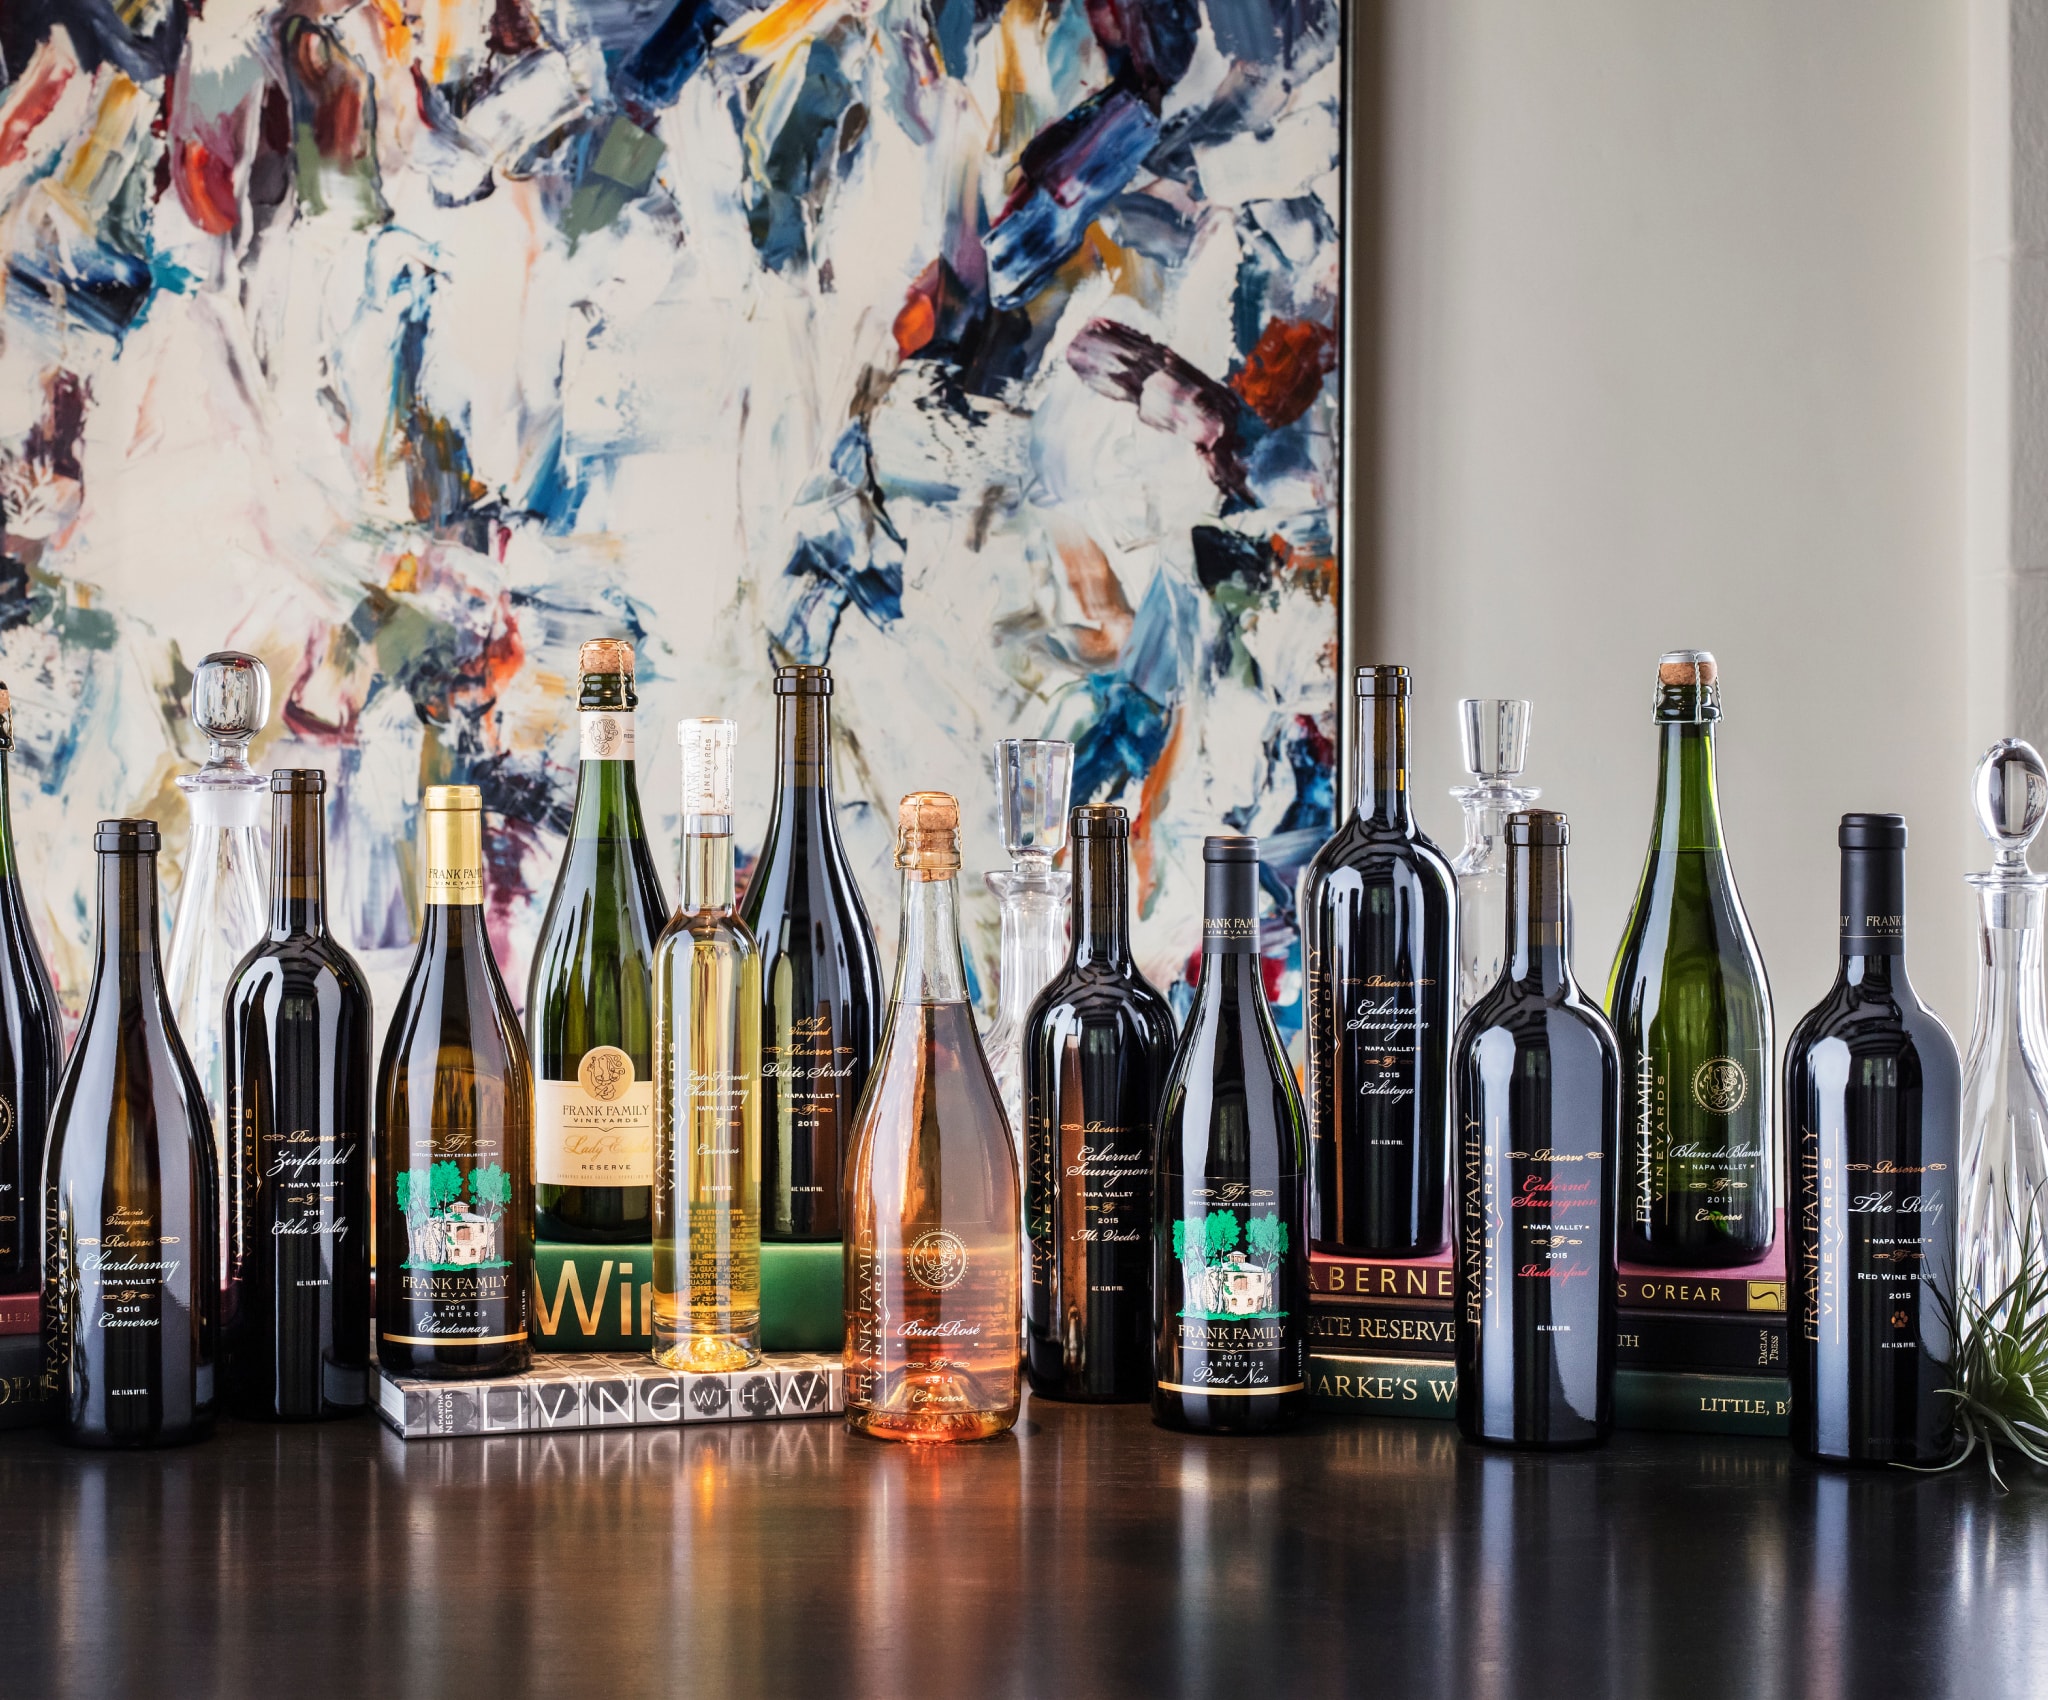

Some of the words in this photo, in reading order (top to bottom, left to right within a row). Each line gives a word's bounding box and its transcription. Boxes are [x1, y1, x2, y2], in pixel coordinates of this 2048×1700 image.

[429, 868, 461, 879] FRANK
[1364, 974, 1415, 988] Reserve
[1357, 996, 1423, 1016] Cabernet
[1345, 1014, 1431, 1042] Sauvignon
[784, 1043, 833, 1056] Reserve
[1324, 972, 1332, 1116] VINEYARDS
[761, 1062, 806, 1078] Petite
[806, 1057, 858, 1080] Sirah
[683, 1081, 750, 1105] Chardonnay
[1311, 1050, 1322, 1140] FRANK
[1360, 1079, 1415, 1105] Calistoga
[1636, 1050, 1654, 1137] FAMILY
[563, 1105, 602, 1116] FRANK
[606, 1105, 650, 1116] FAMILY
[287, 1129, 338, 1143] Reserve
[564, 1135, 603, 1161] Lady
[1029, 1092, 1042, 1185] FAMILY
[1656, 1074, 1665, 1202] VINEYARDS
[266, 1143, 356, 1178] Zinfandel
[1077, 1142, 1141, 1162] Cabernet
[1530, 1148, 1584, 1162] Reserve
[1669, 1141, 1711, 1158] Blanc
[1713, 1146, 1725, 1158] de
[1066, 1162, 1150, 1188] Sauvignon
[1465, 1112, 1481, 1220] FAMILY
[1692, 1163, 1716, 1171] NAPA
[1718, 1163, 1748, 1171] VALLEY
[1802, 1124, 1818, 1233] FAMILY
[1872, 1160, 1927, 1174] Reserve
[245, 1108, 254, 1257] VINEYARDS
[1043, 1117, 1053, 1261] VINEYARDS
[1522, 1172, 1591, 1192] Cabernet
[1636, 1143, 1652, 1223] FRANK
[1511, 1192, 1597, 1219] Sauvignon
[1707, 1196, 1734, 1204] 2013
[1848, 1190, 1893, 1214] The
[1896, 1189, 1944, 1226] Riley
[46, 1178, 58, 1285] FAMILY
[105, 1214, 153, 1232] Vineyard
[271, 1217, 309, 1235] Chiles
[312, 1216, 349, 1243] Valley
[1485, 1144, 1493, 1299] VINEYARDS
[101, 1235, 155, 1248] Reserve
[1031, 1195, 1043, 1286] FRANK
[1071, 1229, 1099, 1242] Mt.
[1101, 1229, 1141, 1242] Veeder
[1823, 1157, 1833, 1316] VINEYARDS
[82, 1250, 181, 1282] Chardonnay
[859, 1227, 872, 1312] FAMILY
[1466, 1225, 1482, 1326] FRANK
[1517, 1263, 1591, 1287] Rutherford
[59, 1209, 71, 1365] VINEYARDS
[125, 1278, 156, 1286] VALLEY
[402, 1276, 452, 1290] FRANK
[456, 1274, 509, 1290] FAMILY
[1641, 1283, 1721, 1301] O'REAR
[1803, 1240, 1819, 1342] FRANK
[1889, 1292, 1912, 1300] 2015
[98, 1312, 160, 1328] Carneros
[416, 1316, 490, 1338] Chardonnay
[897, 1318, 944, 1337] Brut
[937, 1318, 981, 1337] Rosé
[1179, 1324, 1228, 1340] FRANK
[1233, 1324, 1286, 1340] FAMILY
[46, 1293, 59, 1391] FRANK
[860, 1320, 872, 1404] FRANK
[925, 1376, 953, 1384] 2014
[1192, 1366, 1235, 1384] Pinot
[1234, 1367, 1269, 1384] Noir
[1315, 1373, 1418, 1401] ARKE'S
[483, 1383, 681, 1432] LIVING
[693, 1388, 755, 1406] WITH
[912, 1390, 964, 1404] Carneros
[1700, 1397, 1770, 1416] LITTLE,
